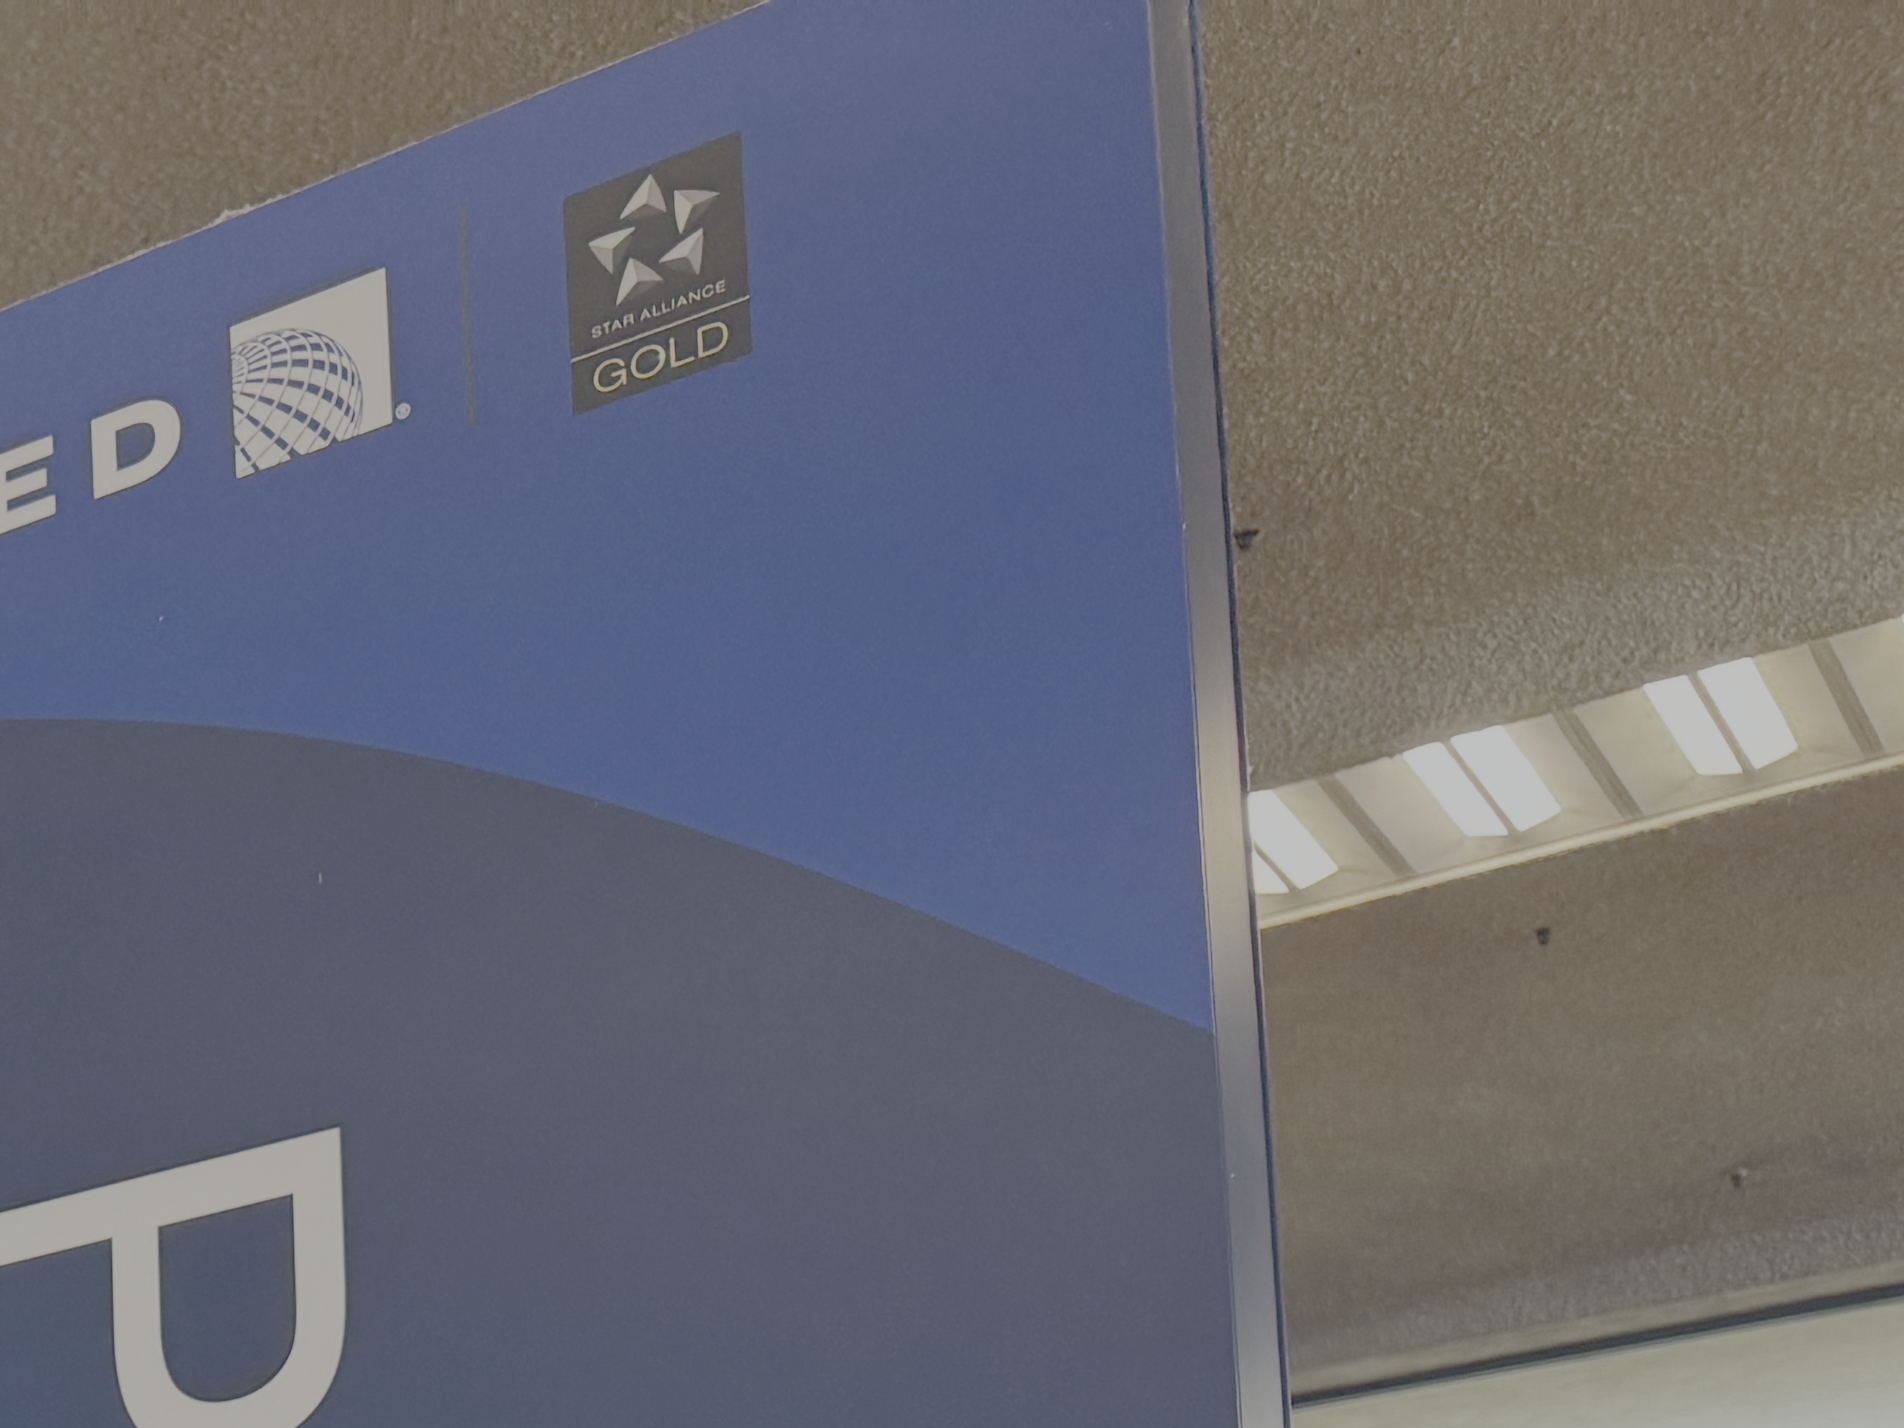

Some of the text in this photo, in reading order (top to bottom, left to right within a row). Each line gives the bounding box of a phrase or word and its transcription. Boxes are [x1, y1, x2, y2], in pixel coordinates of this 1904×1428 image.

[591, 279, 727, 339] STAR ALLIANCE
[593, 320, 730, 393] GOLD
